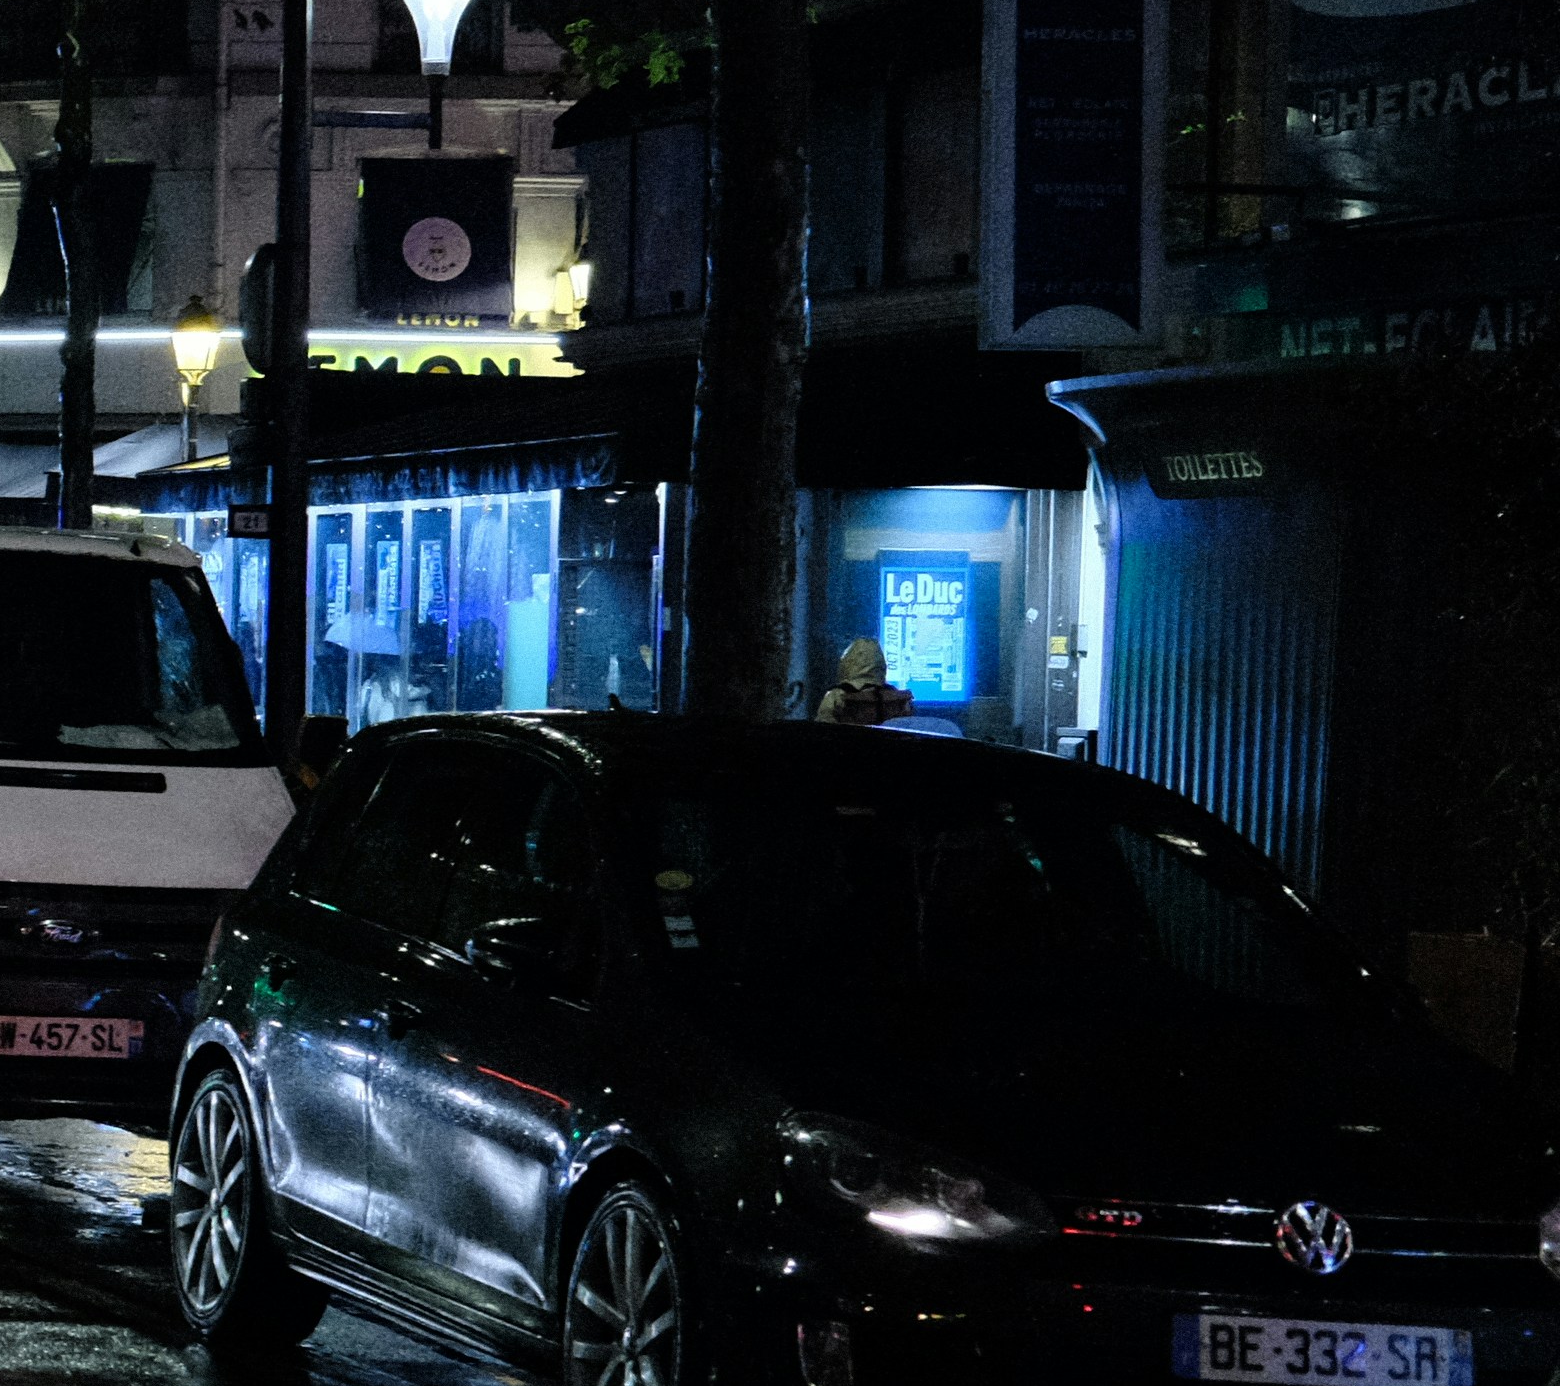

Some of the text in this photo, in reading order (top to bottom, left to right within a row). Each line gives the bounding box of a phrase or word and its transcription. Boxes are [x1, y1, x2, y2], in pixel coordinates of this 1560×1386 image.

[1337, 60, 1560, 130] HERACL
[1162, 451, 1265, 483] TOILETTES
[916, 573, 964, 604] Duc
[886, 620, 899, 671] OCT 2023
